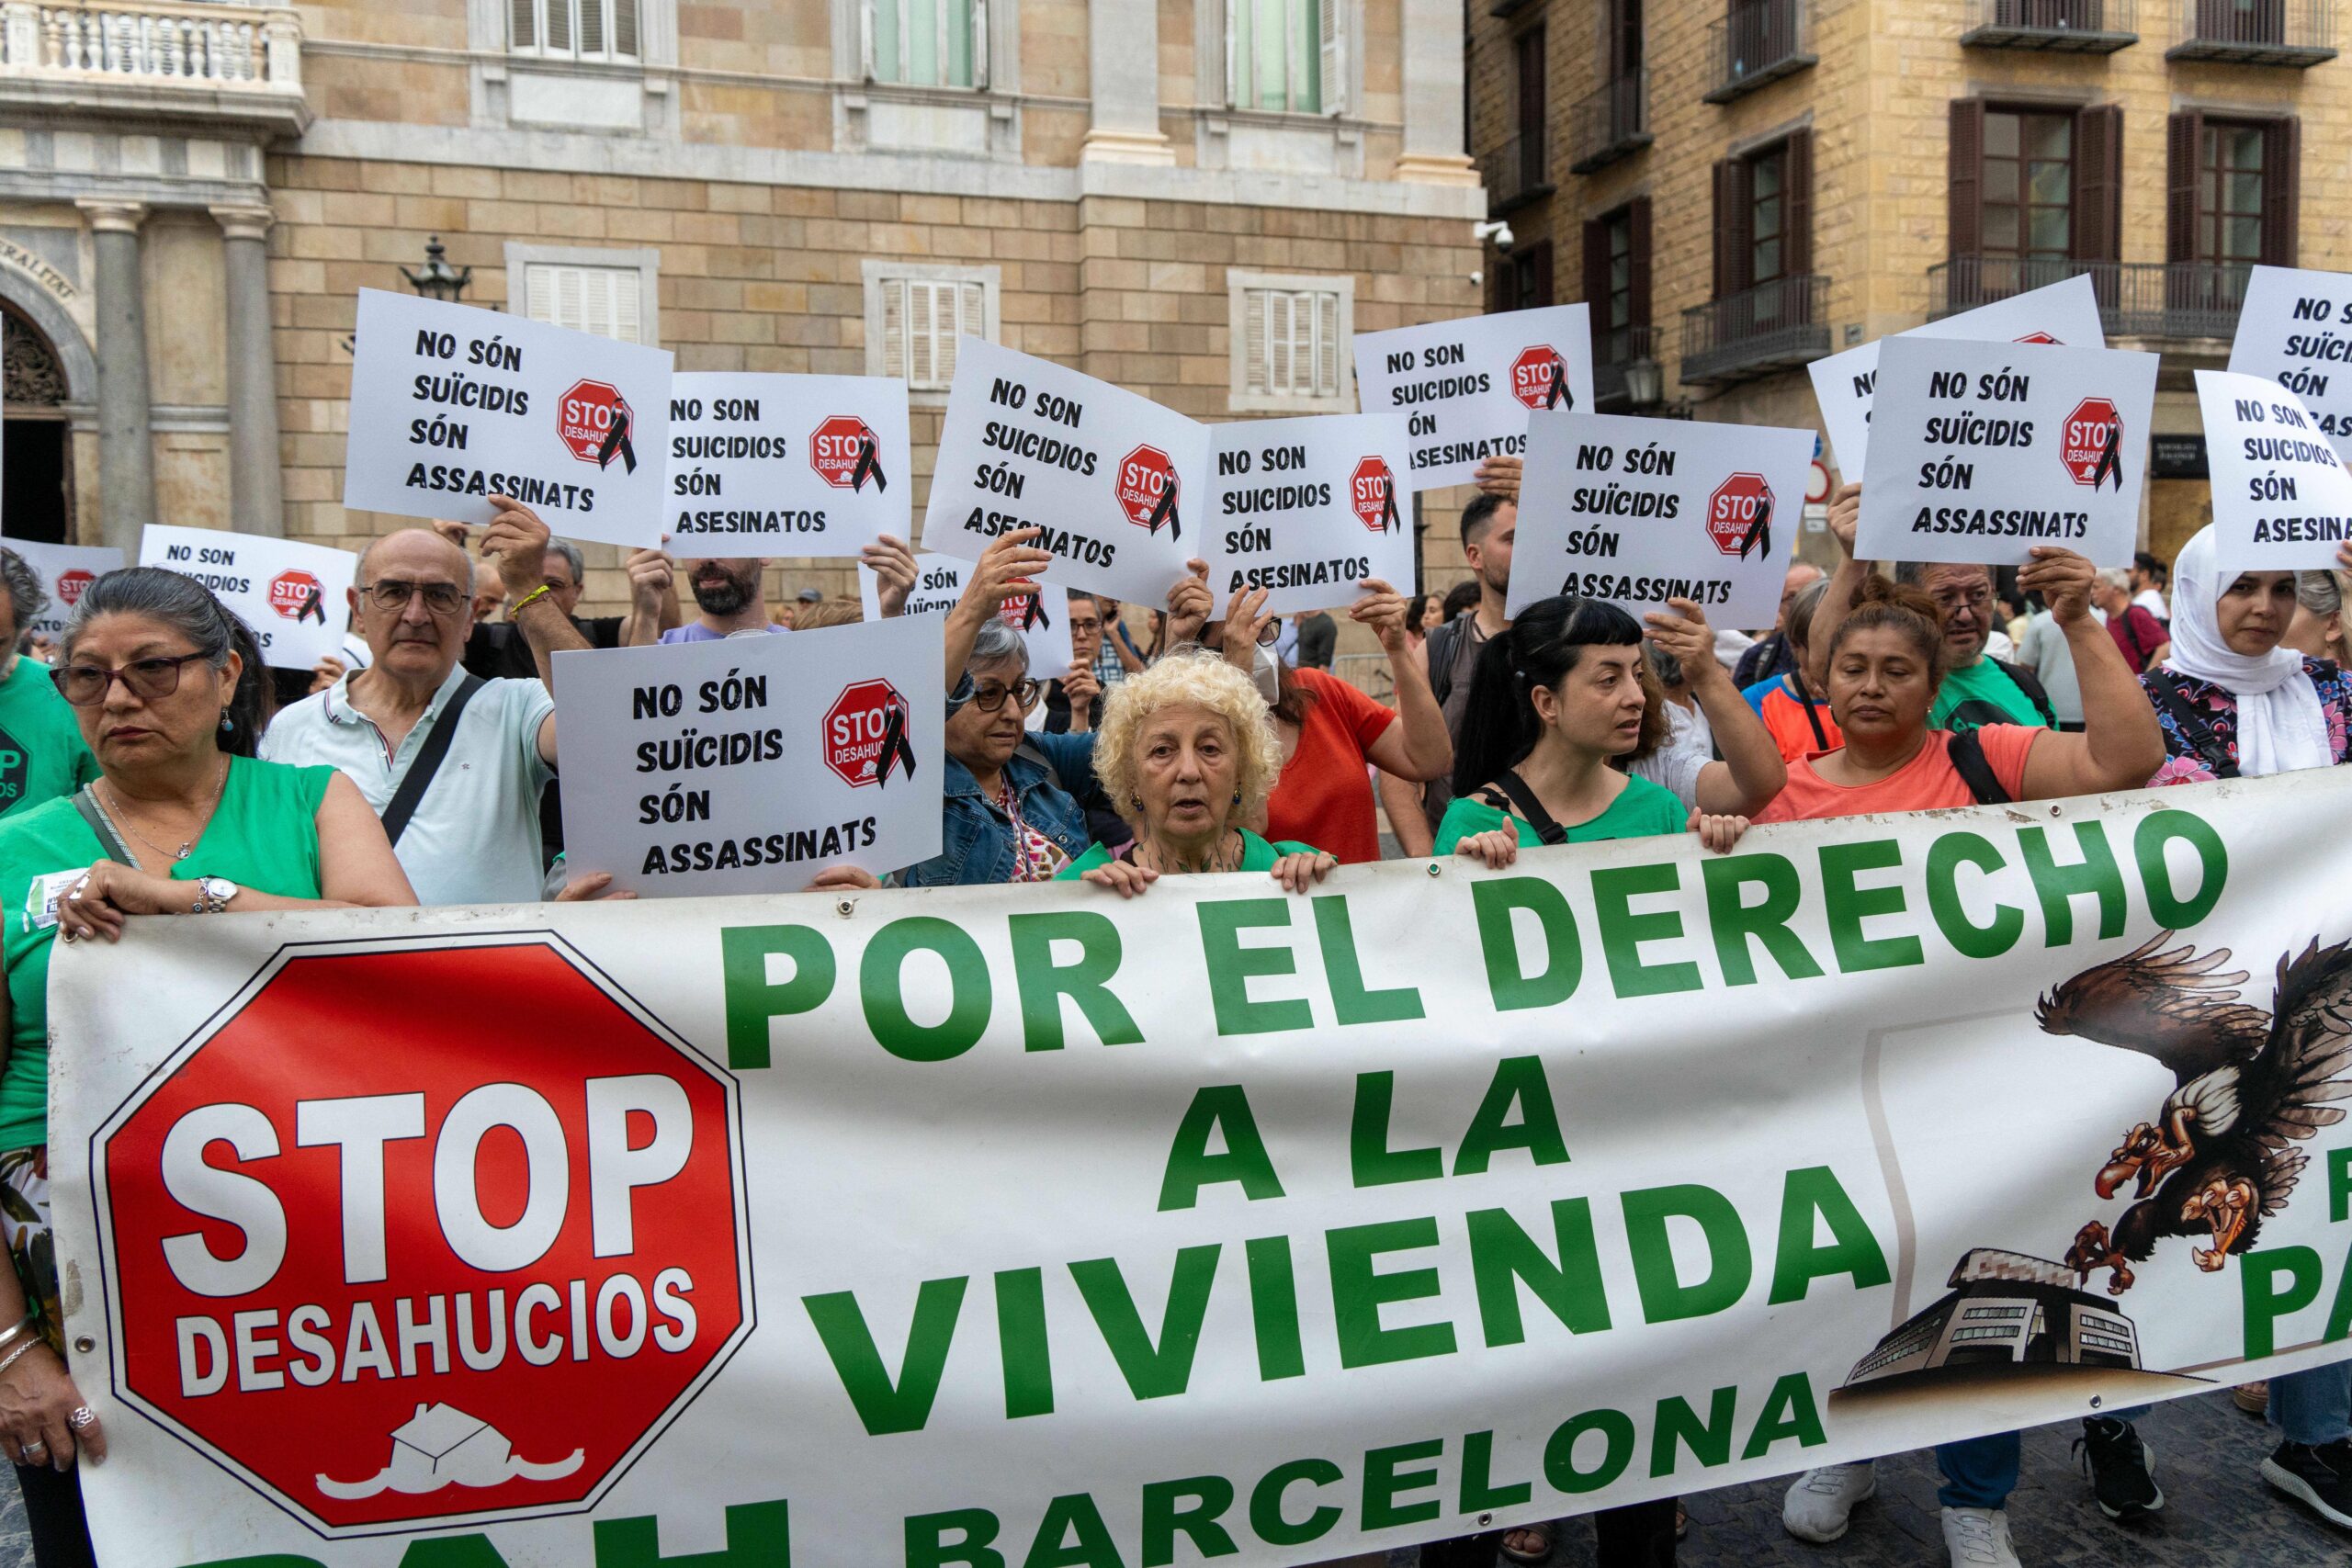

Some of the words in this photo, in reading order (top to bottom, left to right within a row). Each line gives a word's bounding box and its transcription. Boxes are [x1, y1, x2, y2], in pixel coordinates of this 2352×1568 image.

[2293, 298, 2331, 321] NO
[415, 330, 456, 359] NO
[468, 336, 522, 372] SÓN
[1387, 351, 1415, 374] NO
[1424, 344, 1464, 367] SON
[1517, 361, 1558, 384] STO
[1929, 371, 1967, 399] NO
[1976, 367, 2030, 401] SÓN
[413, 372, 528, 415] SUÏCIDIS
[990, 378, 1026, 410] NO
[1034, 392, 1082, 428] SON
[1392, 373, 1490, 406] SUICIDIOS
[565, 399, 623, 430] STO
[671, 399, 702, 421] NO
[713, 399, 759, 421] SON
[1408, 411, 1437, 436] ÓN
[2235, 400, 2265, 422] NO
[2275, 403, 2307, 430] SON
[410, 413, 468, 449] SÓN
[1924, 411, 2033, 447] SUÏCIDIS
[2069, 421, 2116, 448] STO
[673, 436, 786, 458] SUICIDIOS
[818, 435, 868, 457] STO
[982, 421, 1097, 477] SUICIDIOS
[1219, 450, 1250, 475] NO
[1261, 446, 1306, 471] SON
[1577, 445, 1613, 471] NO
[1623, 442, 1676, 476] SÓN
[2244, 438, 2337, 468] SUICIDIOS
[406, 463, 594, 513] ASSASSINATS
[673, 467, 720, 496] SÓN
[974, 462, 1025, 499] SÓN
[1125, 463, 1172, 492] STO
[1356, 477, 1389, 500] STO
[1918, 455, 1973, 490] SÓN
[2250, 470, 2297, 502] SÓN
[1222, 483, 1331, 514] SUICIDIOS
[1571, 482, 1679, 519] SUÏCIDIS
[1715, 495, 1766, 520] STO
[676, 511, 826, 534] ASESINATOS
[1225, 522, 1272, 554] SÓN
[1912, 507, 2088, 538] ASSASSINATS
[167, 545, 191, 560] NO
[198, 548, 235, 566] SON
[1566, 524, 1619, 557] SÓN
[274, 581, 317, 597] STO
[923, 567, 957, 590] SÓN
[1228, 557, 1369, 593] ASESINATOS
[1560, 572, 1732, 604] ASSASSINATS
[633, 683, 683, 719] NO
[699, 668, 767, 714] SÓN
[832, 705, 897, 746] STO
[636, 728, 783, 773] SUÏCIDIS
[639, 783, 710, 824] SÓN
[641, 816, 876, 875] ASSASSINATS
[720, 910, 1147, 1070] POR
[1195, 894, 1427, 1037] EL
[1471, 808, 2229, 1012] DERECHO
[1156, 1083, 1286, 1213] A
[1349, 1055, 1570, 1188] LA
[160, 1073, 695, 1299] STOP
[800, 1166, 1891, 1437] VIVIENDA
[175, 1267, 697, 1399] DESAHUCIOS
[903, 1371, 1827, 1568] BARCELONA
